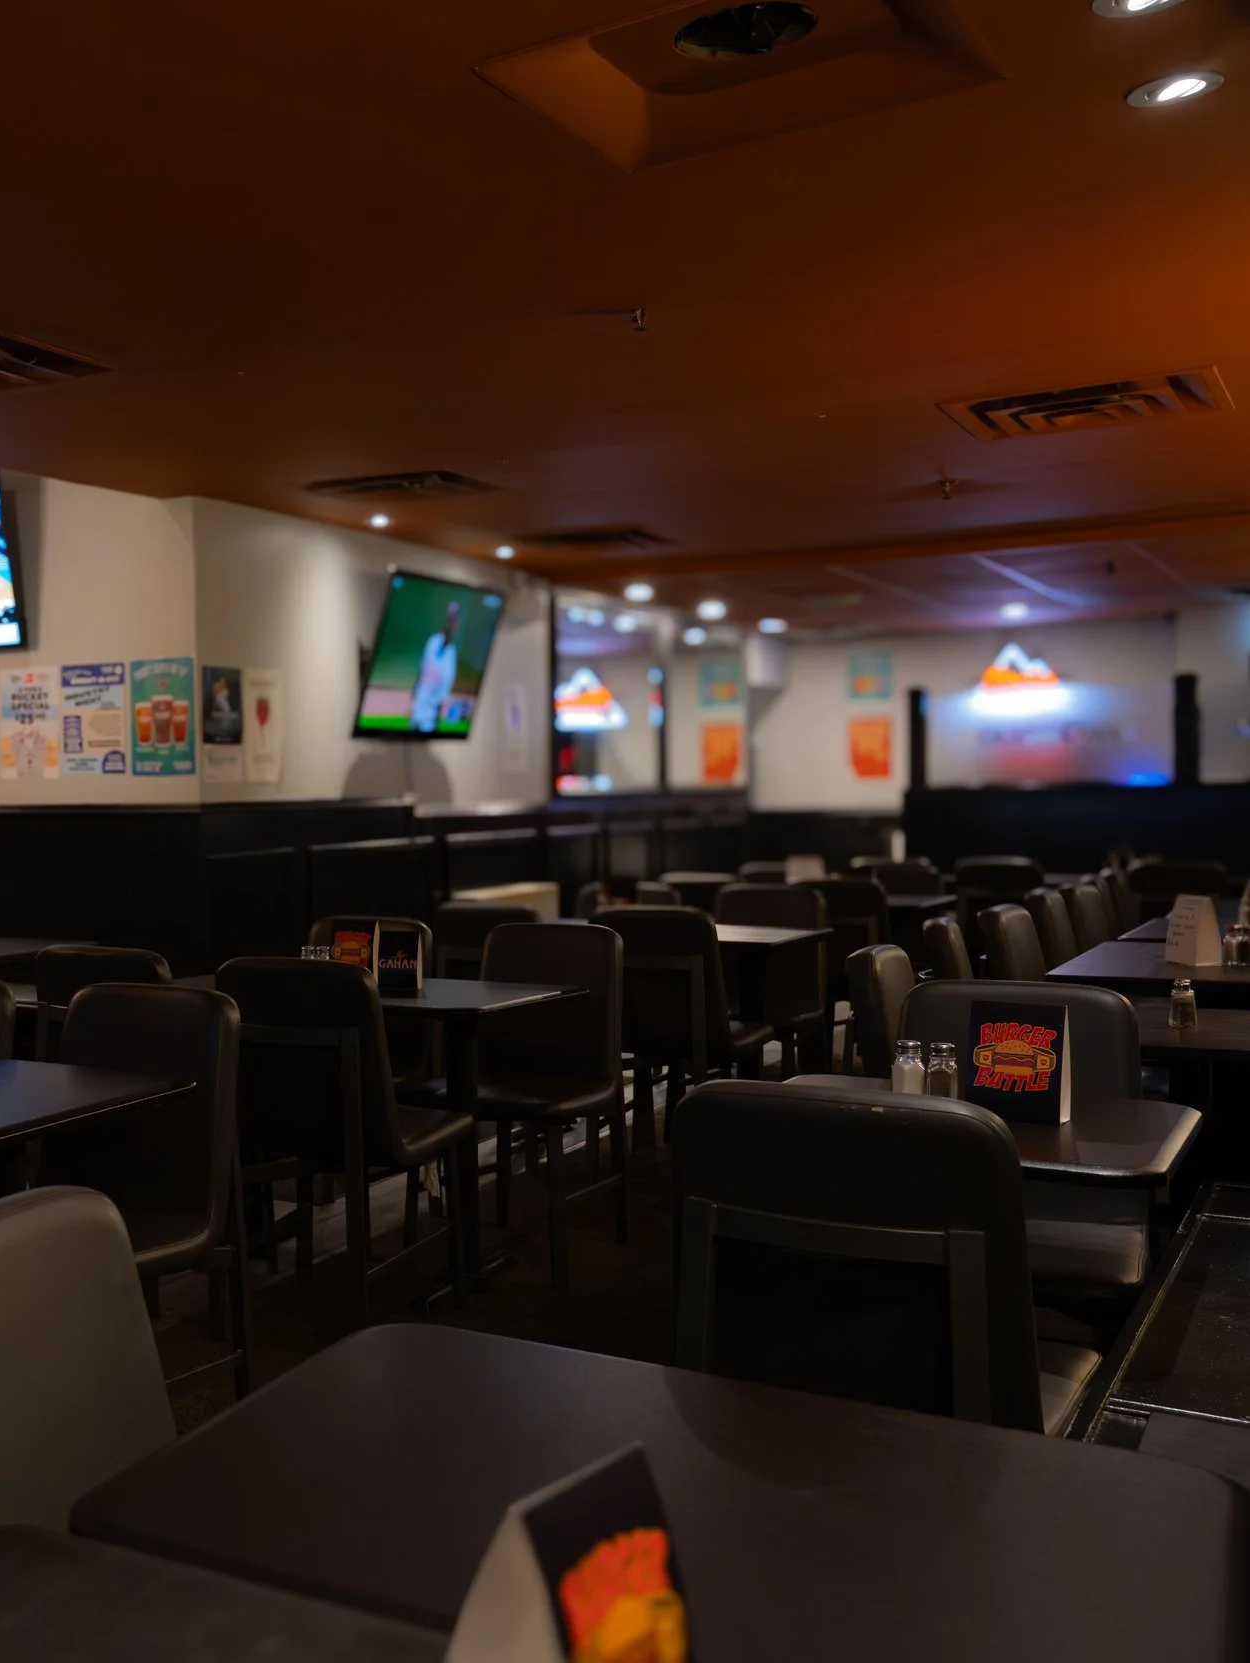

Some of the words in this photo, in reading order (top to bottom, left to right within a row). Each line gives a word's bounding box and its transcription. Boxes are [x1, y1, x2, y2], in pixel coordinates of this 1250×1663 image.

[378, 958, 417, 969] GAHAN
[980, 1022, 1057, 1049] BURGER
[973, 1066, 1051, 1092] BATTLE
